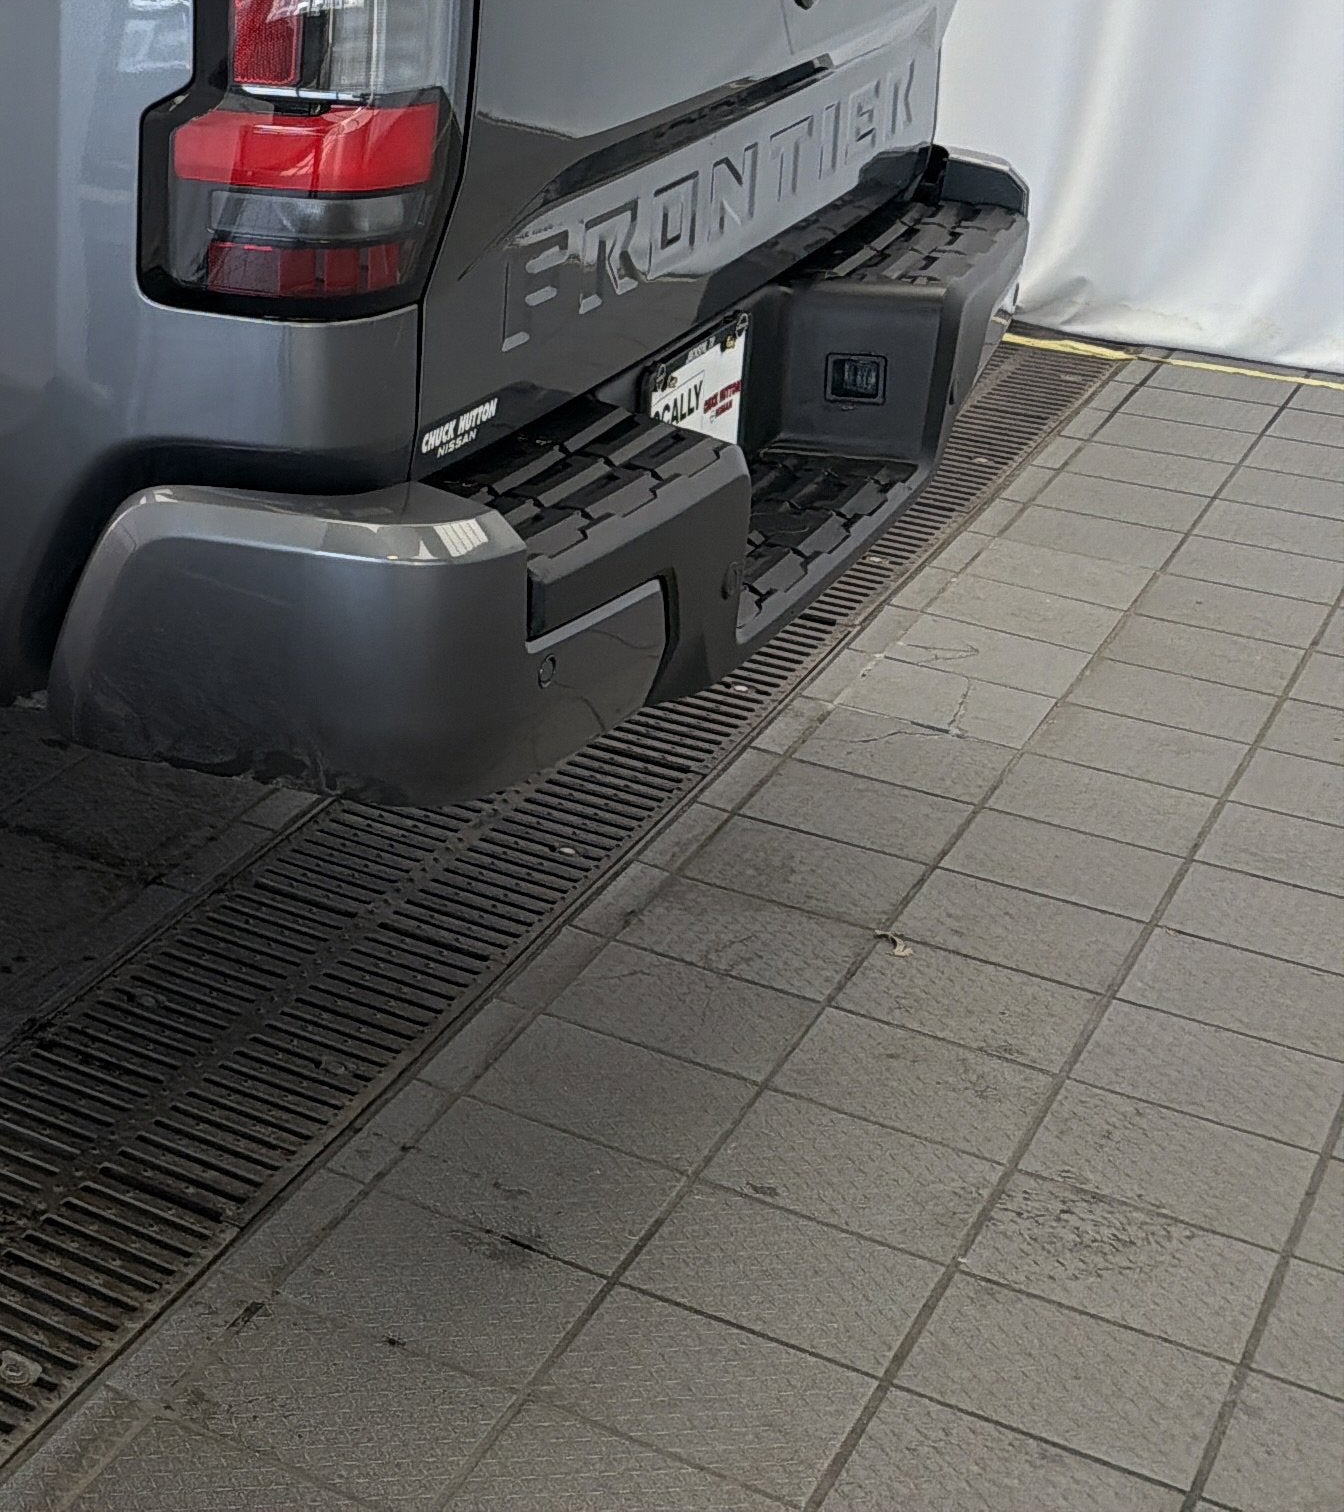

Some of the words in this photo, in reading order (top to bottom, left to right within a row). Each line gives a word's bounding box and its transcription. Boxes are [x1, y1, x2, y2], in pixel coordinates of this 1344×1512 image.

[501, 58, 918, 352] FRONTIER
[421, 418, 457, 454] CHUCK
[457, 397, 498, 436] HUTTON
[436, 428, 478, 459] NISSAN
